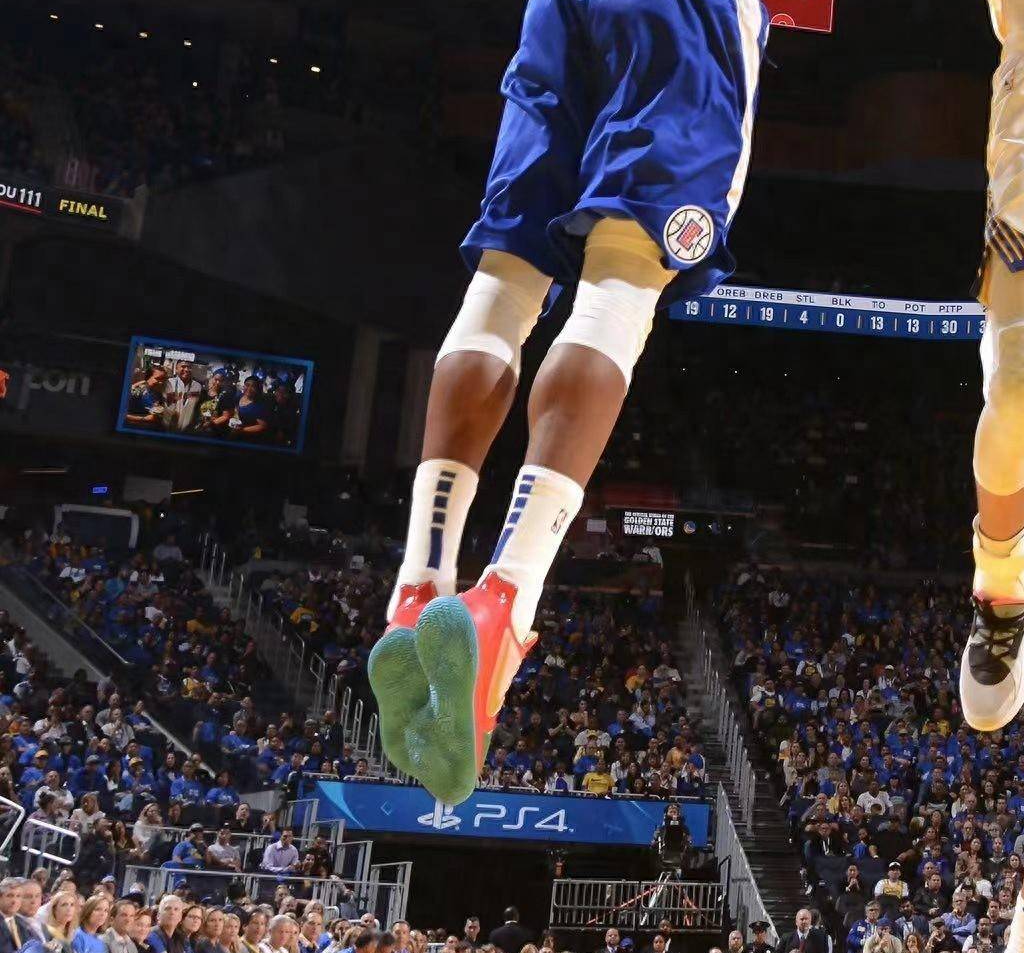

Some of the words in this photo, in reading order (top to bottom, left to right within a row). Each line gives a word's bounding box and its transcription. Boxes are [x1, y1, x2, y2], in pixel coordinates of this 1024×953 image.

[19, 188, 42, 207] 111
[59, 199, 107, 218] FINAL
[717, 288, 746, 298] OREB
[754, 290, 783, 300] DREB
[796, 295, 815, 304] STL
[832, 298, 851, 307] BLK
[872, 301, 886, 309] TO
[905, 303, 926, 312] POT
[939, 304, 963, 313] PITP
[685, 301, 699, 315] 19
[723, 304, 737, 319] 12
[760, 307, 774, 321] 19
[799, 310, 808, 324] 4
[836, 313, 845, 327] 0
[870, 316, 884, 330] 13
[906, 319, 920, 333] 13
[941, 320, 957, 334] 30
[624, 517, 652, 525] GOLDEN
[653, 518, 674, 526] STATE
[624, 525, 673, 537] WARRIORS
[473, 803, 569, 832] PS4
